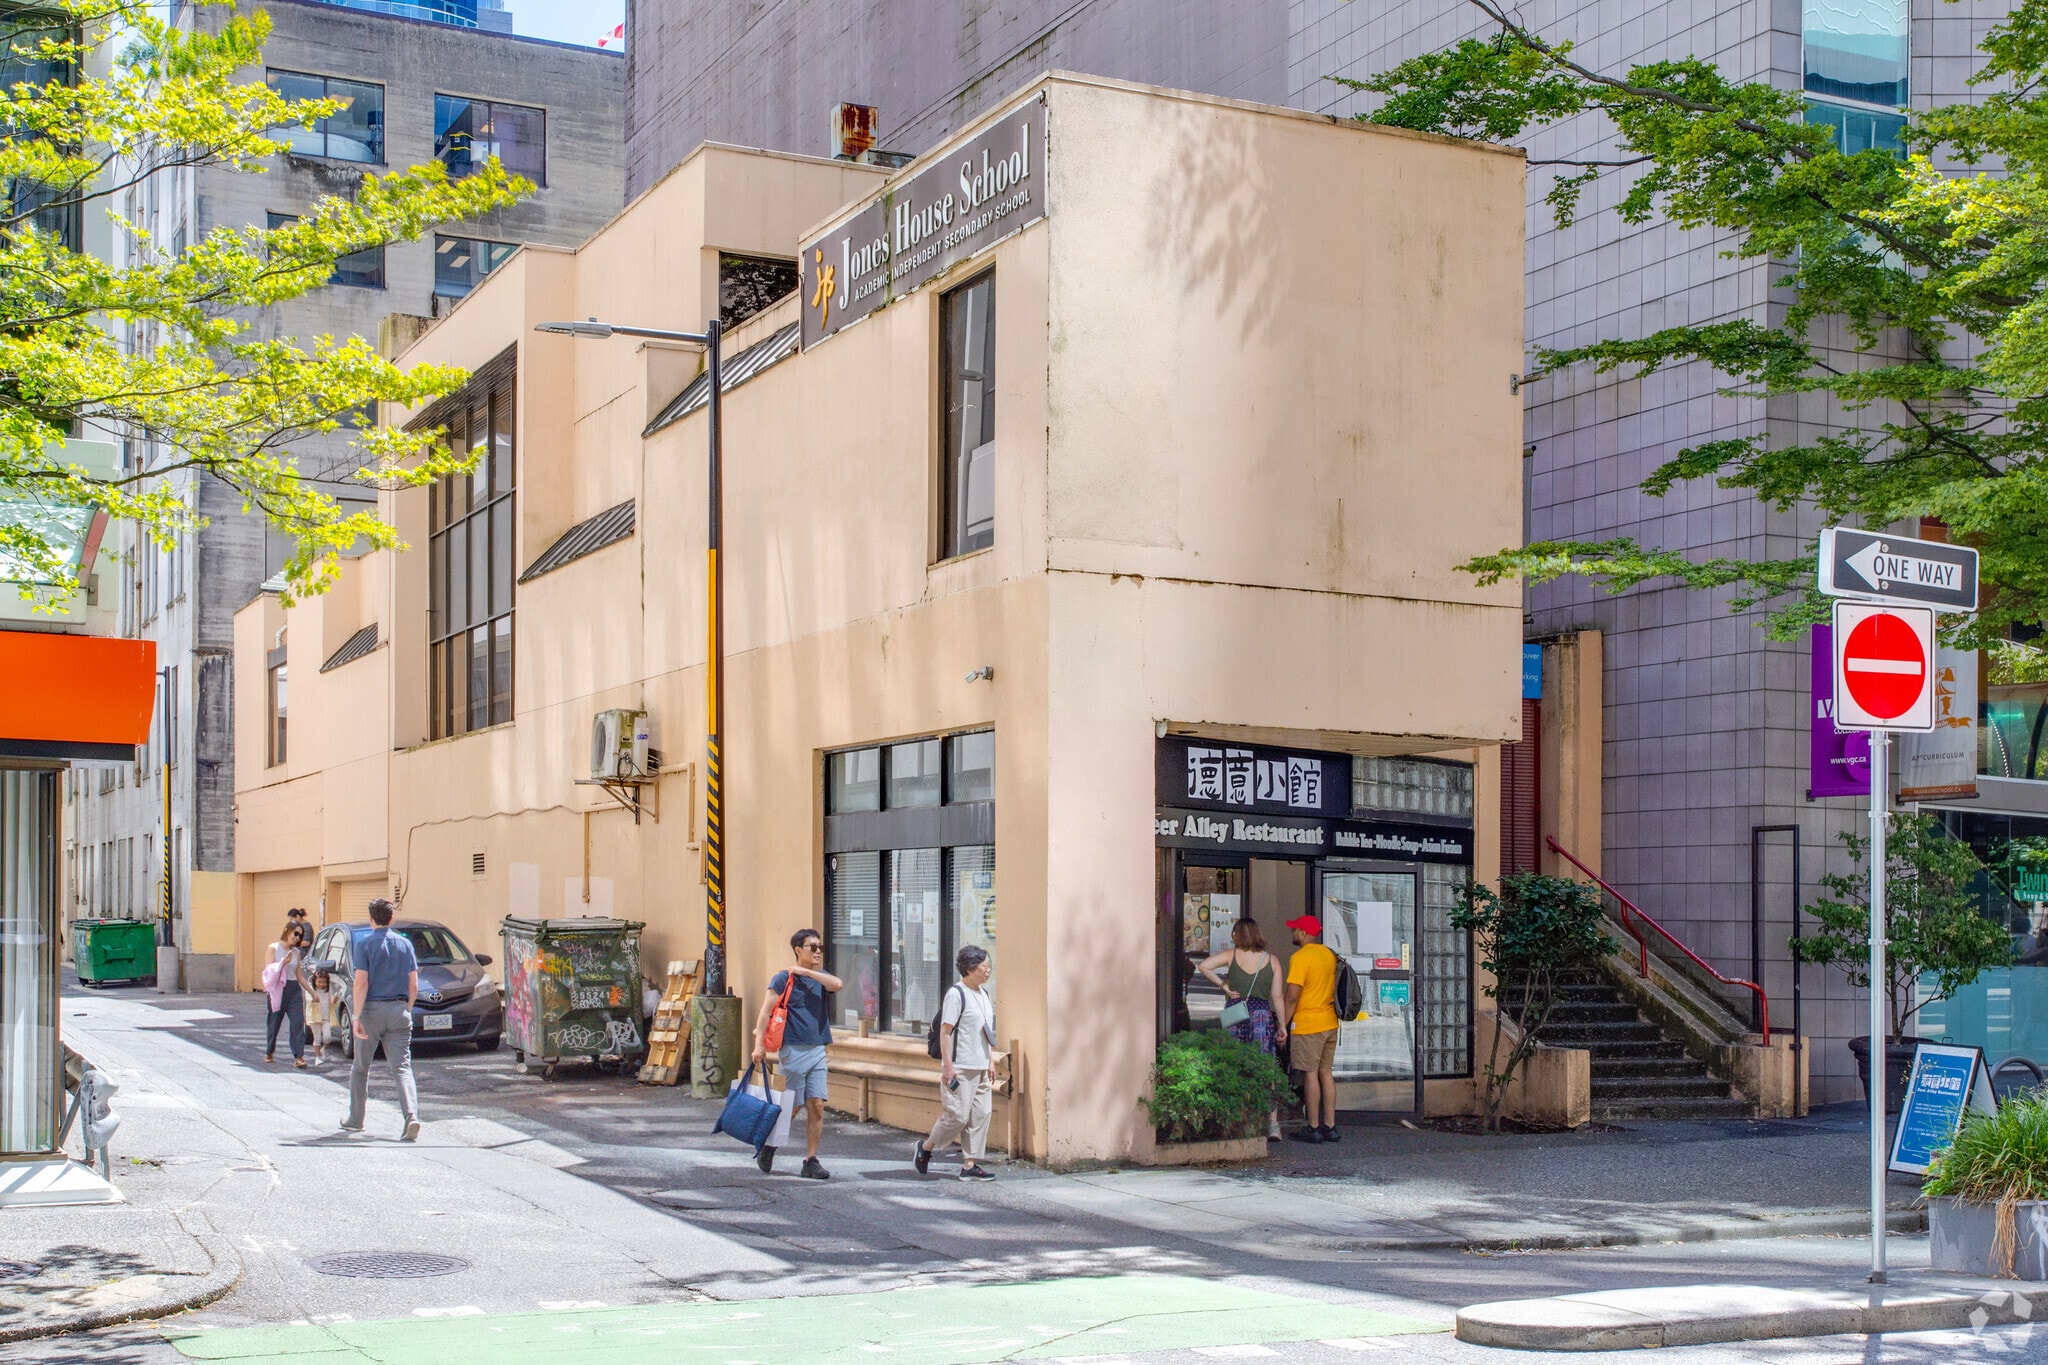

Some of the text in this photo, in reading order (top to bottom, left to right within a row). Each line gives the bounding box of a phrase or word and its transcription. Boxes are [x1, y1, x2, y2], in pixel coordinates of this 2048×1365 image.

[839, 232, 890, 310] Jones
[895, 193, 954, 255] House
[960, 123, 1030, 215] School
[854, 272, 891, 302] ACADEMIC
[892, 240, 943, 280] INDEPENDENT
[944, 209, 995, 249] SECONDARY
[995, 189, 1032, 220] SCHOOL
[1873, 555, 1954, 586] ONE WAY
[1830, 756, 1867, 766] www.vgc.ca
[1922, 752, 1965, 761] CURRICULUM
[1183, 814, 1229, 844] Alley
[1232, 818, 1324, 845] Restaurant
